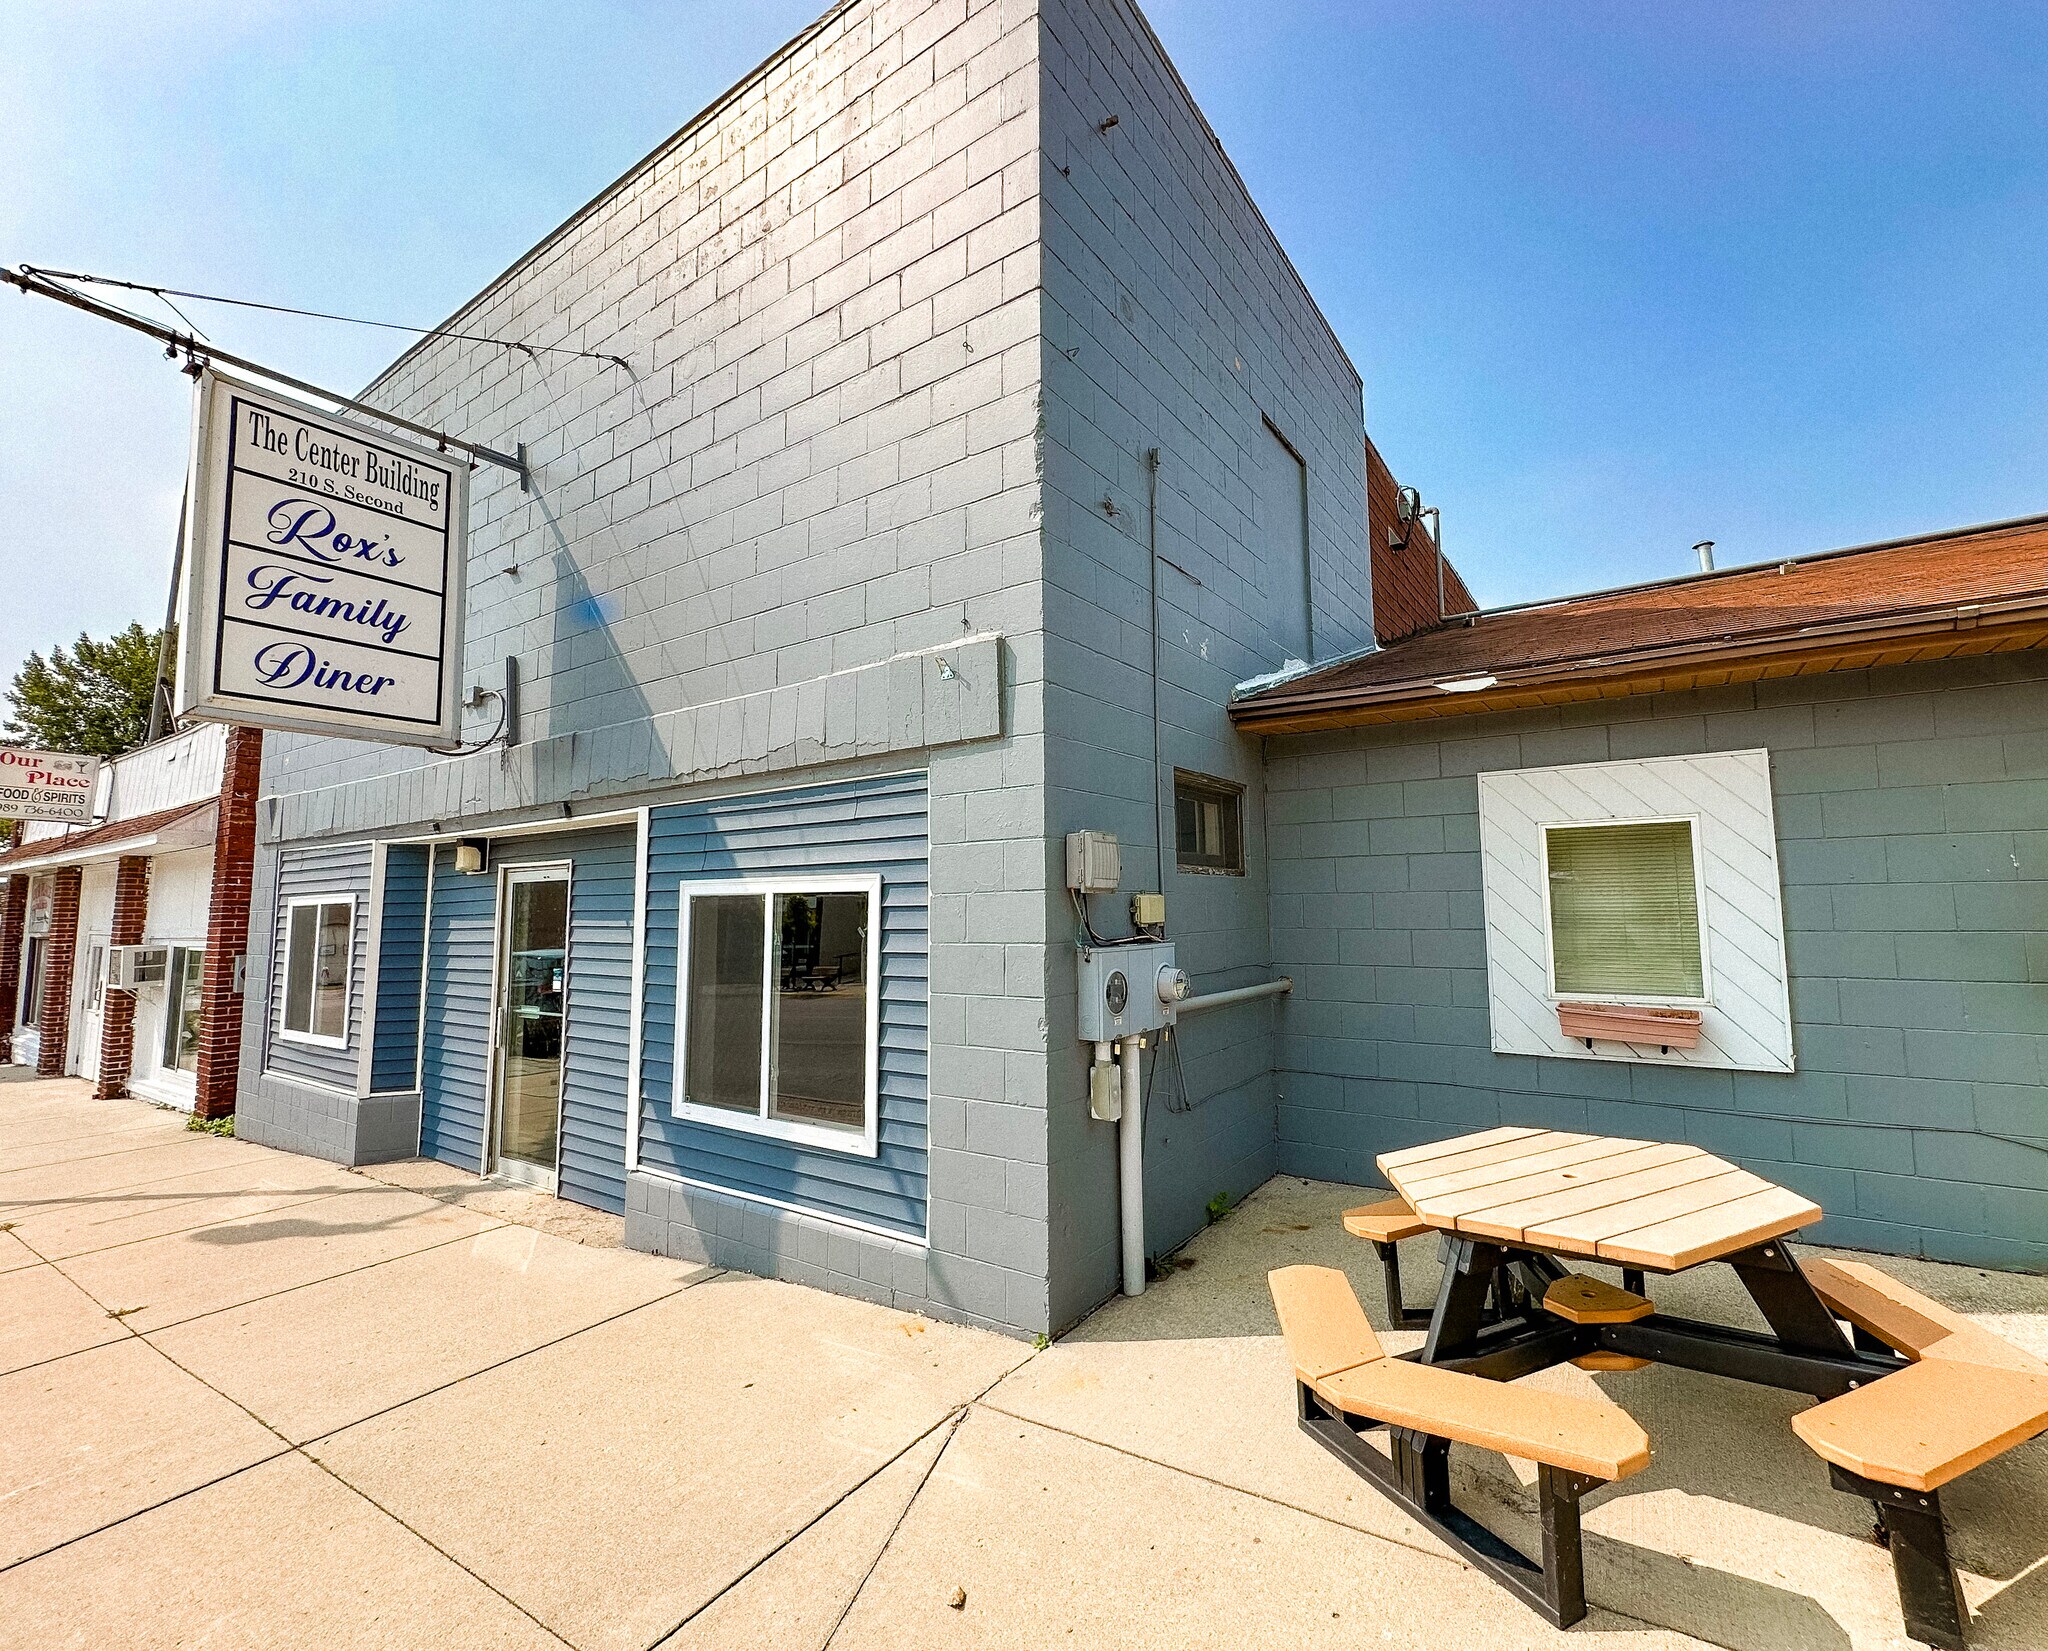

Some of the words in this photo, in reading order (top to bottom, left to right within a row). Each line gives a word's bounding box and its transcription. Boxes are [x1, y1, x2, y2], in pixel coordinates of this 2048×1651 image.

[249, 411, 288, 456] The
[295, 427, 360, 478] Center
[365, 450, 440, 511] Building
[288, 468, 318, 488] 210
[323, 478, 339, 496] S.
[344, 485, 404, 515] Second
[267, 498, 406, 567] Rox's
[245, 565, 412, 643] Family
[254, 642, 395, 696] Diner
[0, 751, 43, 768] Our
[25, 770, 91, 788] Place
[0, 803, 19, 813] 89
[24, 805, 84, 817] 736-6400
[31, 787, 43, 803] &
[43, 791, 86, 804] SPIRITS
